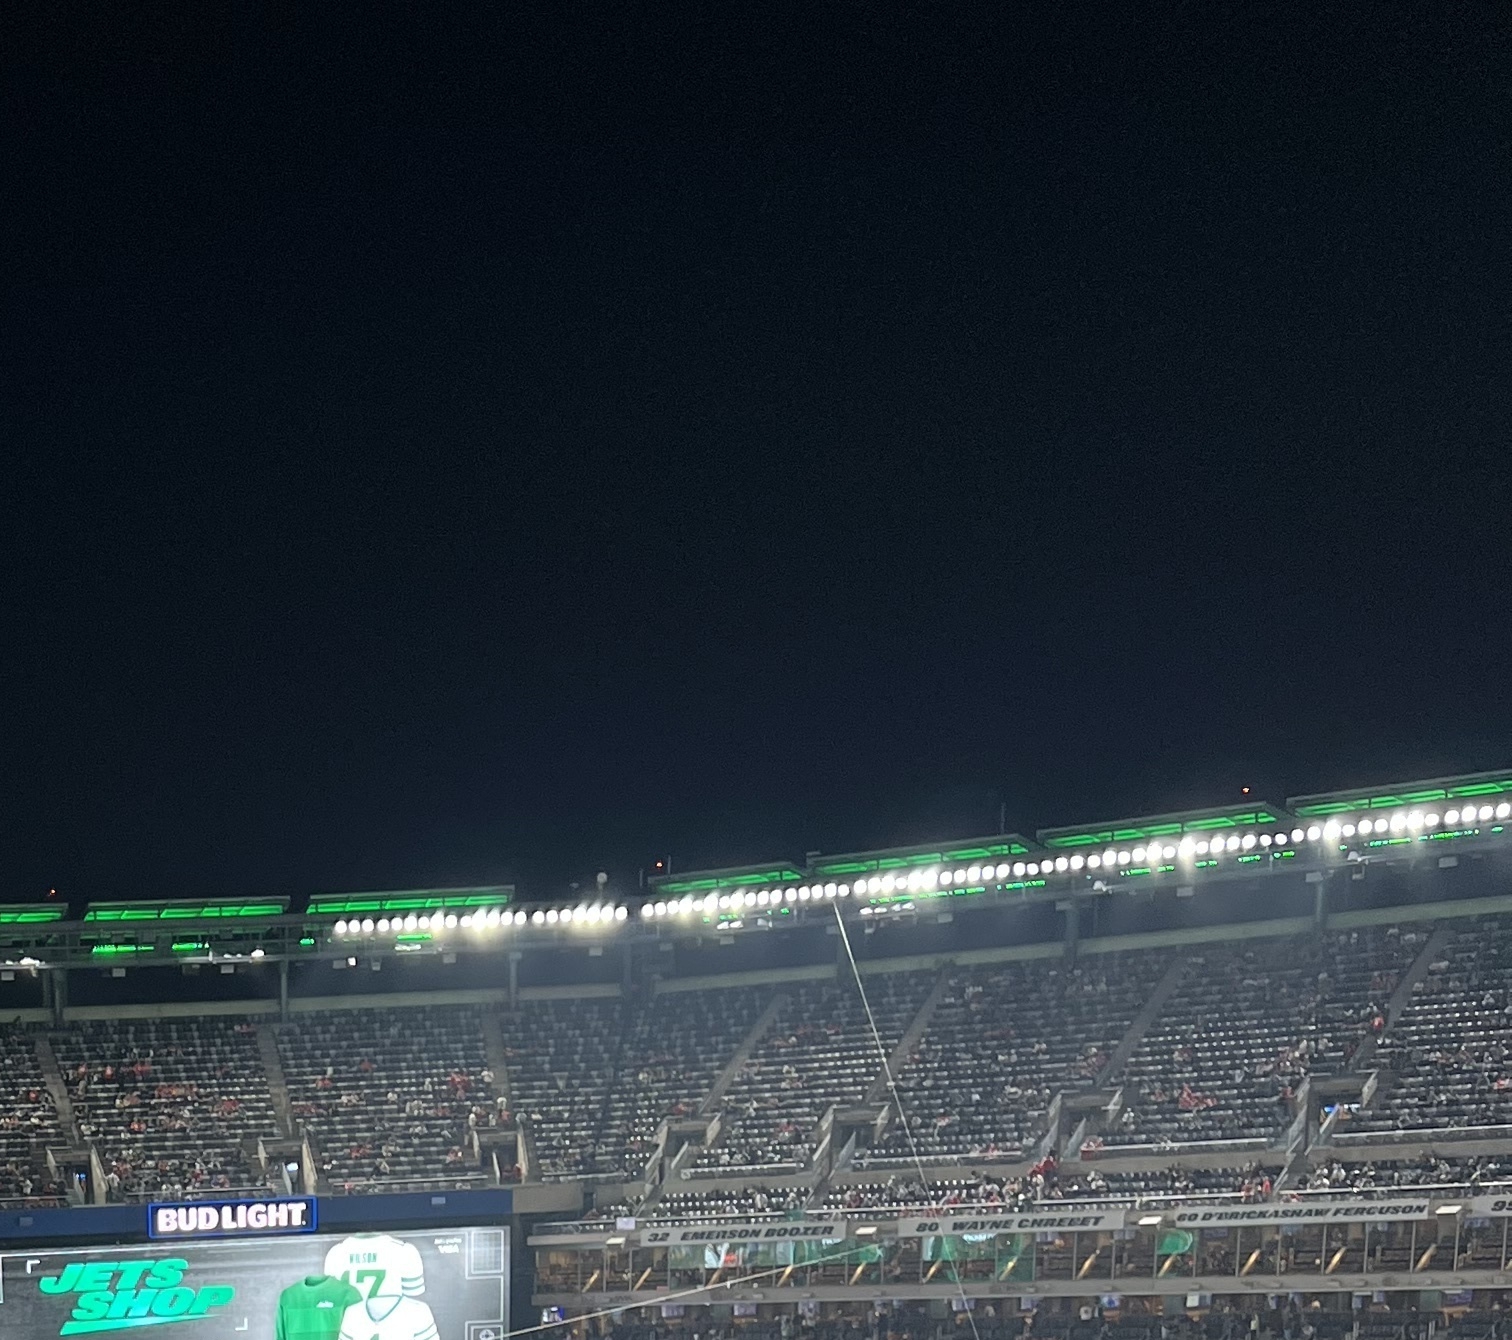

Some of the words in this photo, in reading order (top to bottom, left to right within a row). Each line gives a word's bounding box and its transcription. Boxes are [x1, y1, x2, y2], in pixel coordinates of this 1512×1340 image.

[155, 1206, 217, 1232] BUD
[1332, 1203, 1427, 1218] FERGUSON
[952, 1218, 1014, 1231] WAYNE
[647, 1231, 670, 1242] 32
[680, 1227, 760, 1241] EMERSON
[764, 1225, 834, 1238] BOOZER
[349, 1251, 377, 1264] WILSON
[39, 1258, 189, 1294] JETS
[71, 1285, 236, 1320] SHOP
